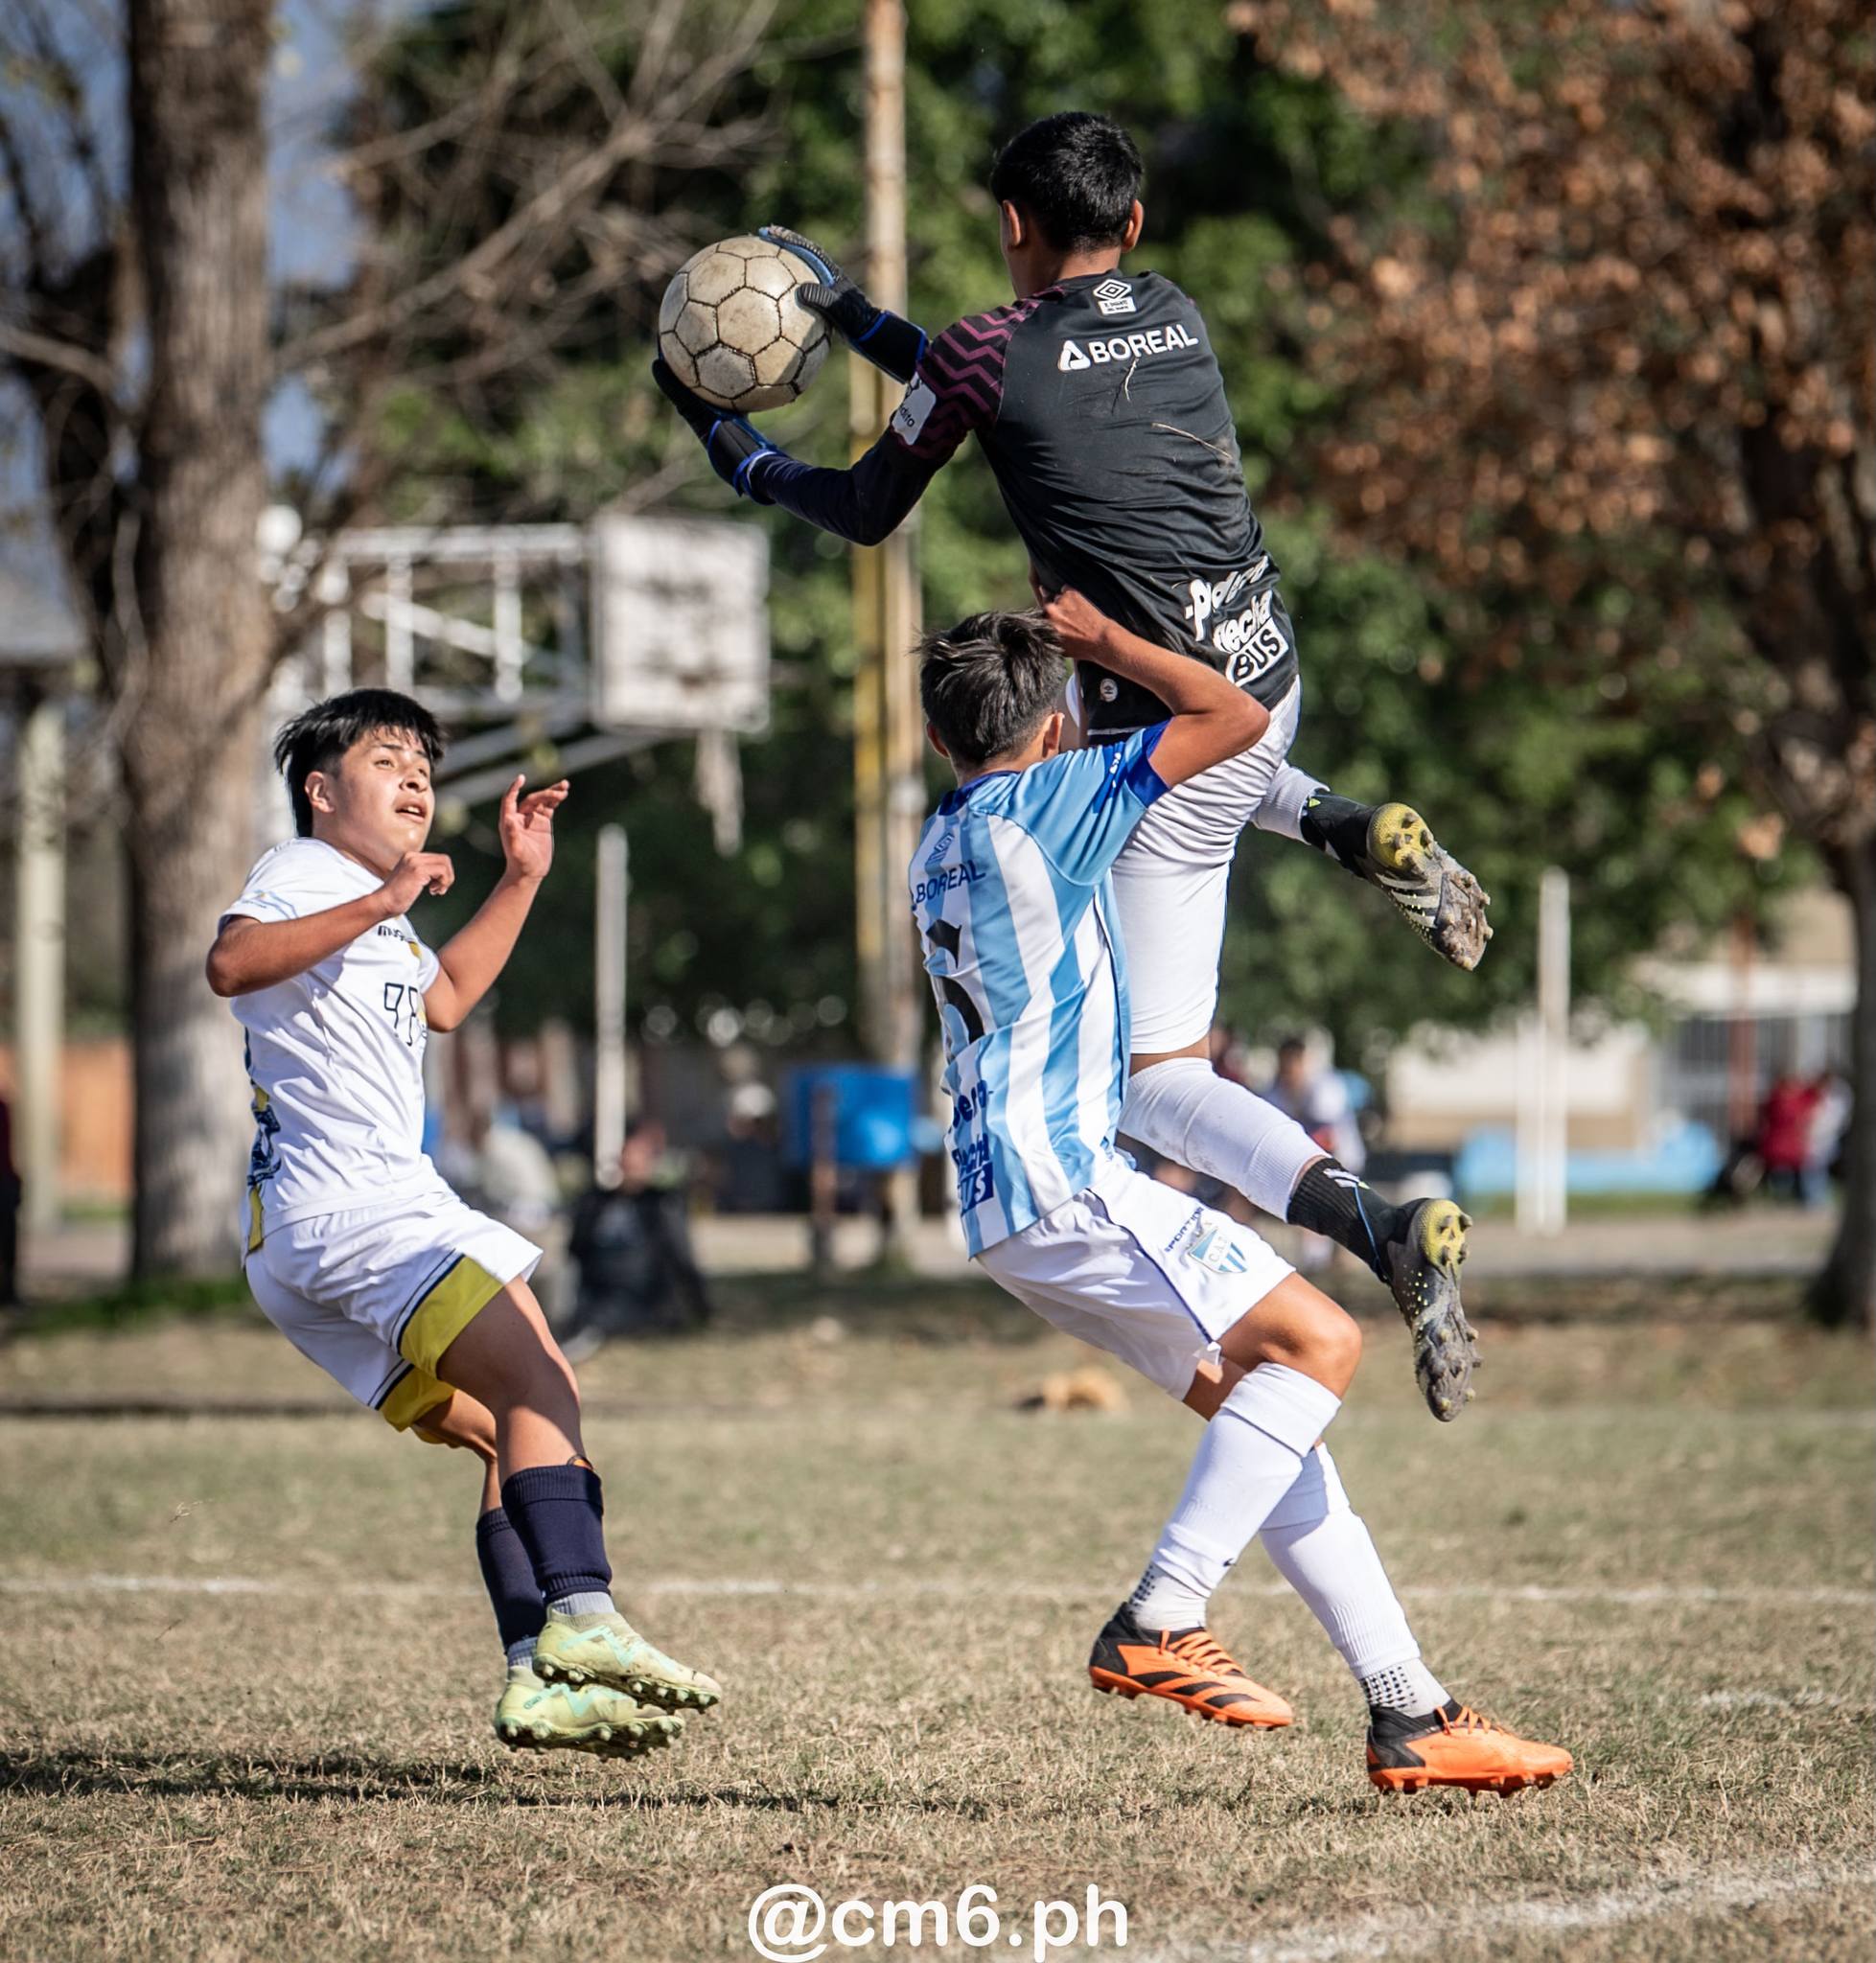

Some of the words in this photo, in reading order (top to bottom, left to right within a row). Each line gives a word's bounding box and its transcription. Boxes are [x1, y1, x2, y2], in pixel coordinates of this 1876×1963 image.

[1088, 324, 1198, 363] BOREAL
[1233, 628, 1281, 681] BUS
[916, 859, 985, 903] BOREAL
